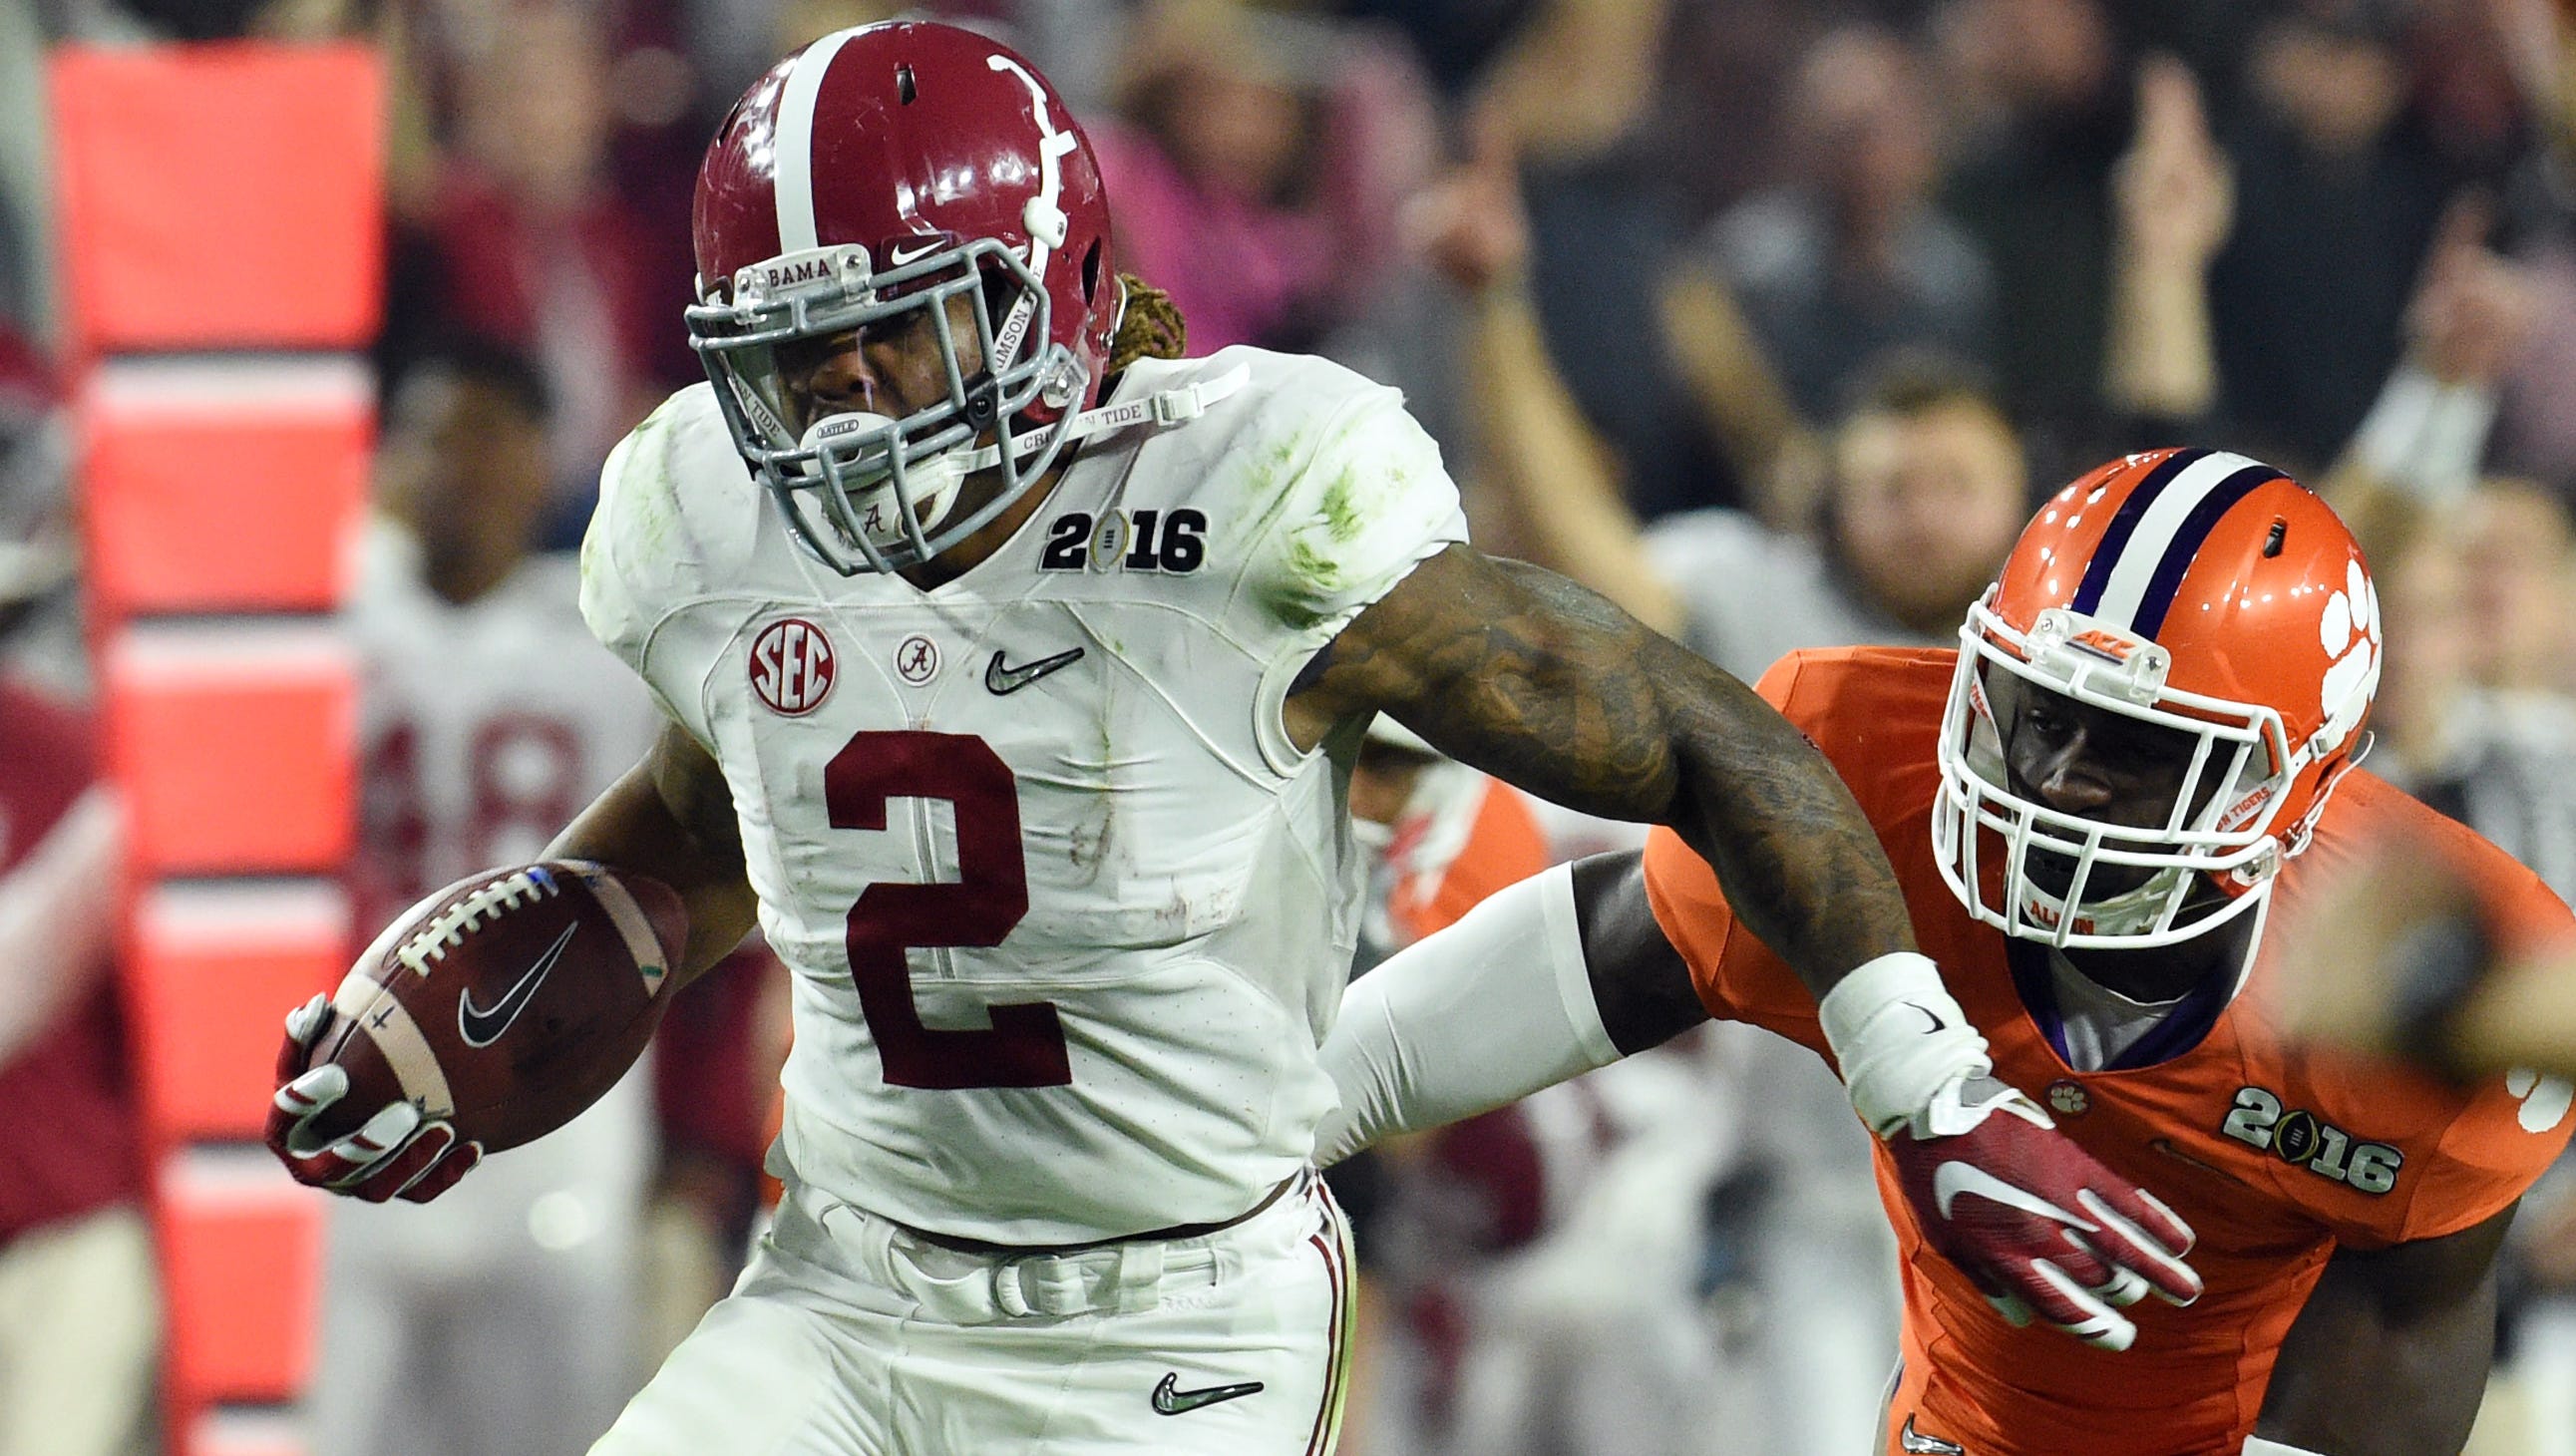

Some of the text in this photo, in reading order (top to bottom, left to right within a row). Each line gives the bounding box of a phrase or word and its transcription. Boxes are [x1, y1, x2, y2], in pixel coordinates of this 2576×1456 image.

[768, 258, 832, 287] BAMA
[996, 309, 1028, 369] IMSON
[753, 401, 780, 437] TIDE
[1101, 405, 1141, 425] TIDE
[865, 503, 886, 535] A
[753, 621, 831, 710] SEC
[2230, 786, 2271, 817] TIGERS
[825, 730, 1072, 1090] 2
